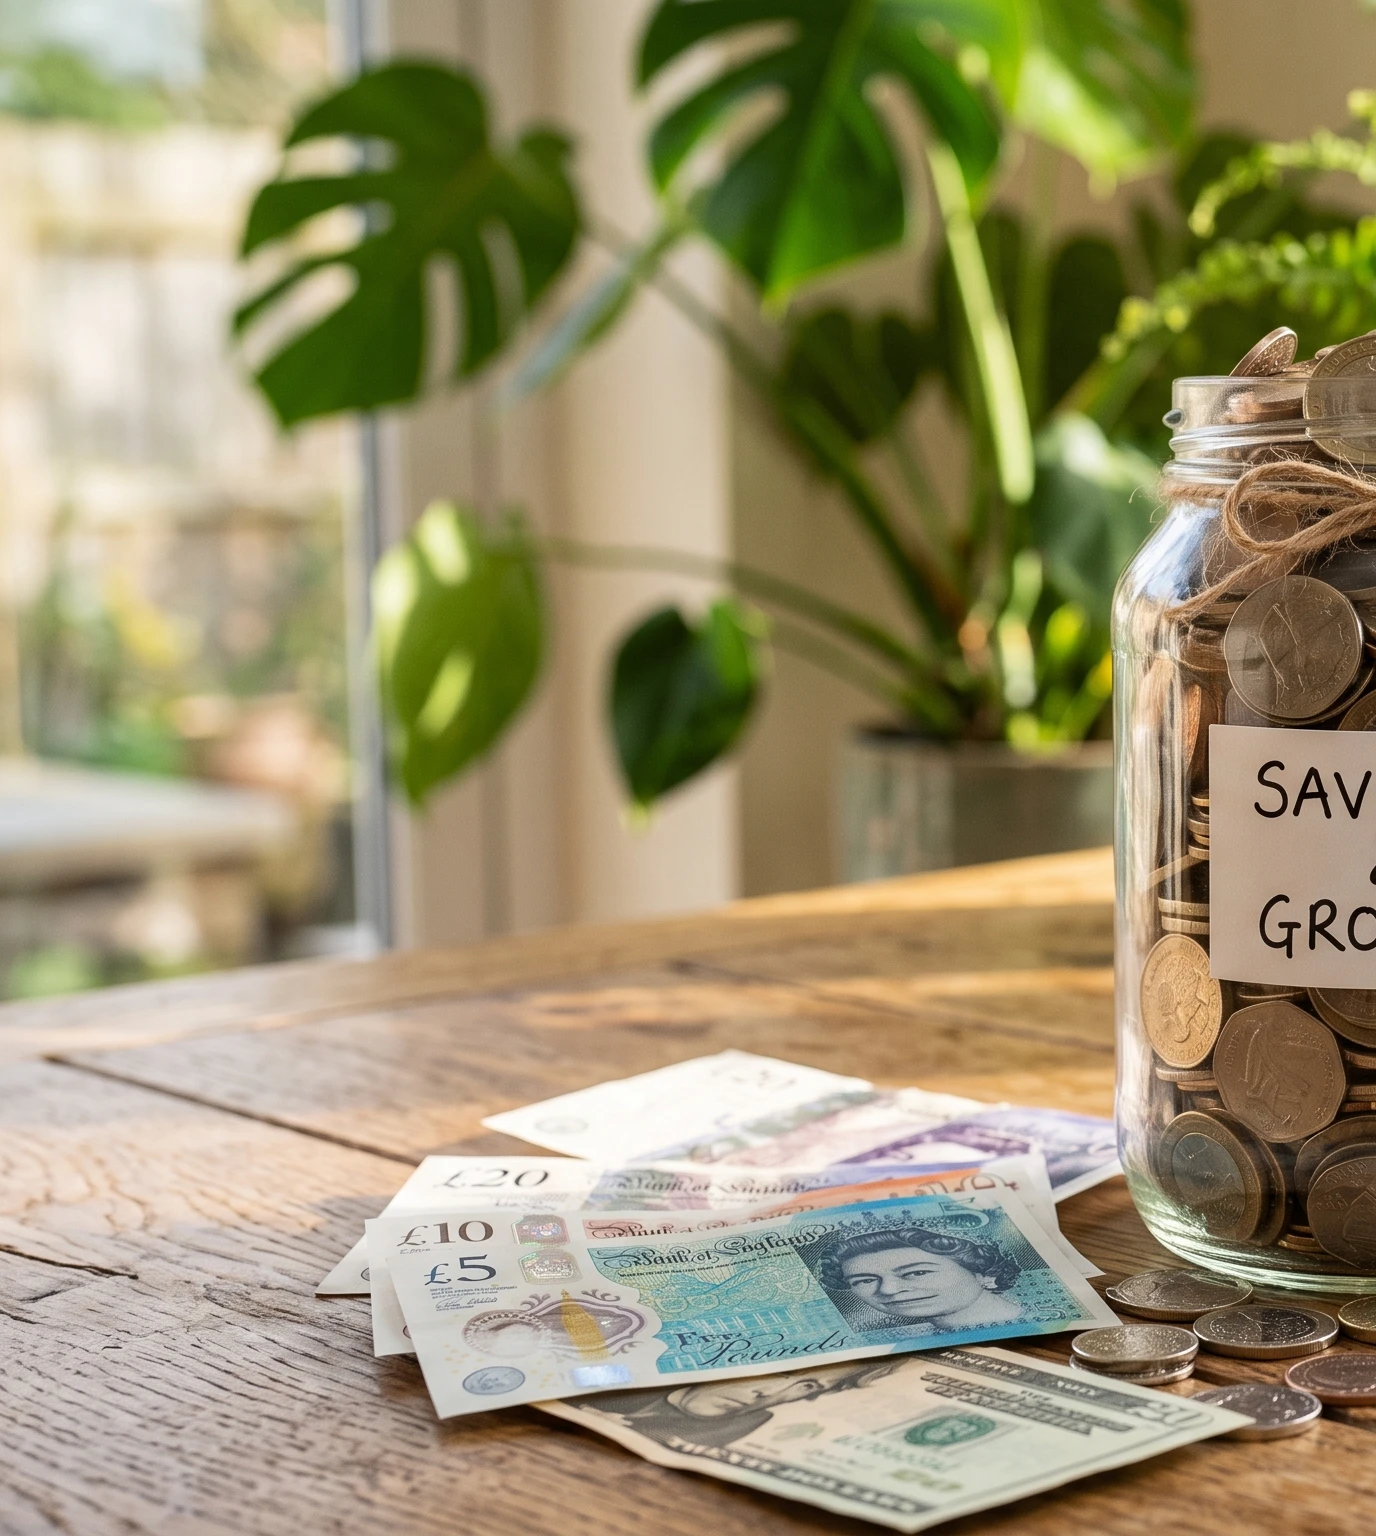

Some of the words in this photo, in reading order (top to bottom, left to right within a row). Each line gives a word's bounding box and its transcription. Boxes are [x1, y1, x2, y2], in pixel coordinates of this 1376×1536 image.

[436, 1167, 550, 1189] £20
[396, 1220, 494, 1248] £10
[423, 1254, 497, 1286] £5
